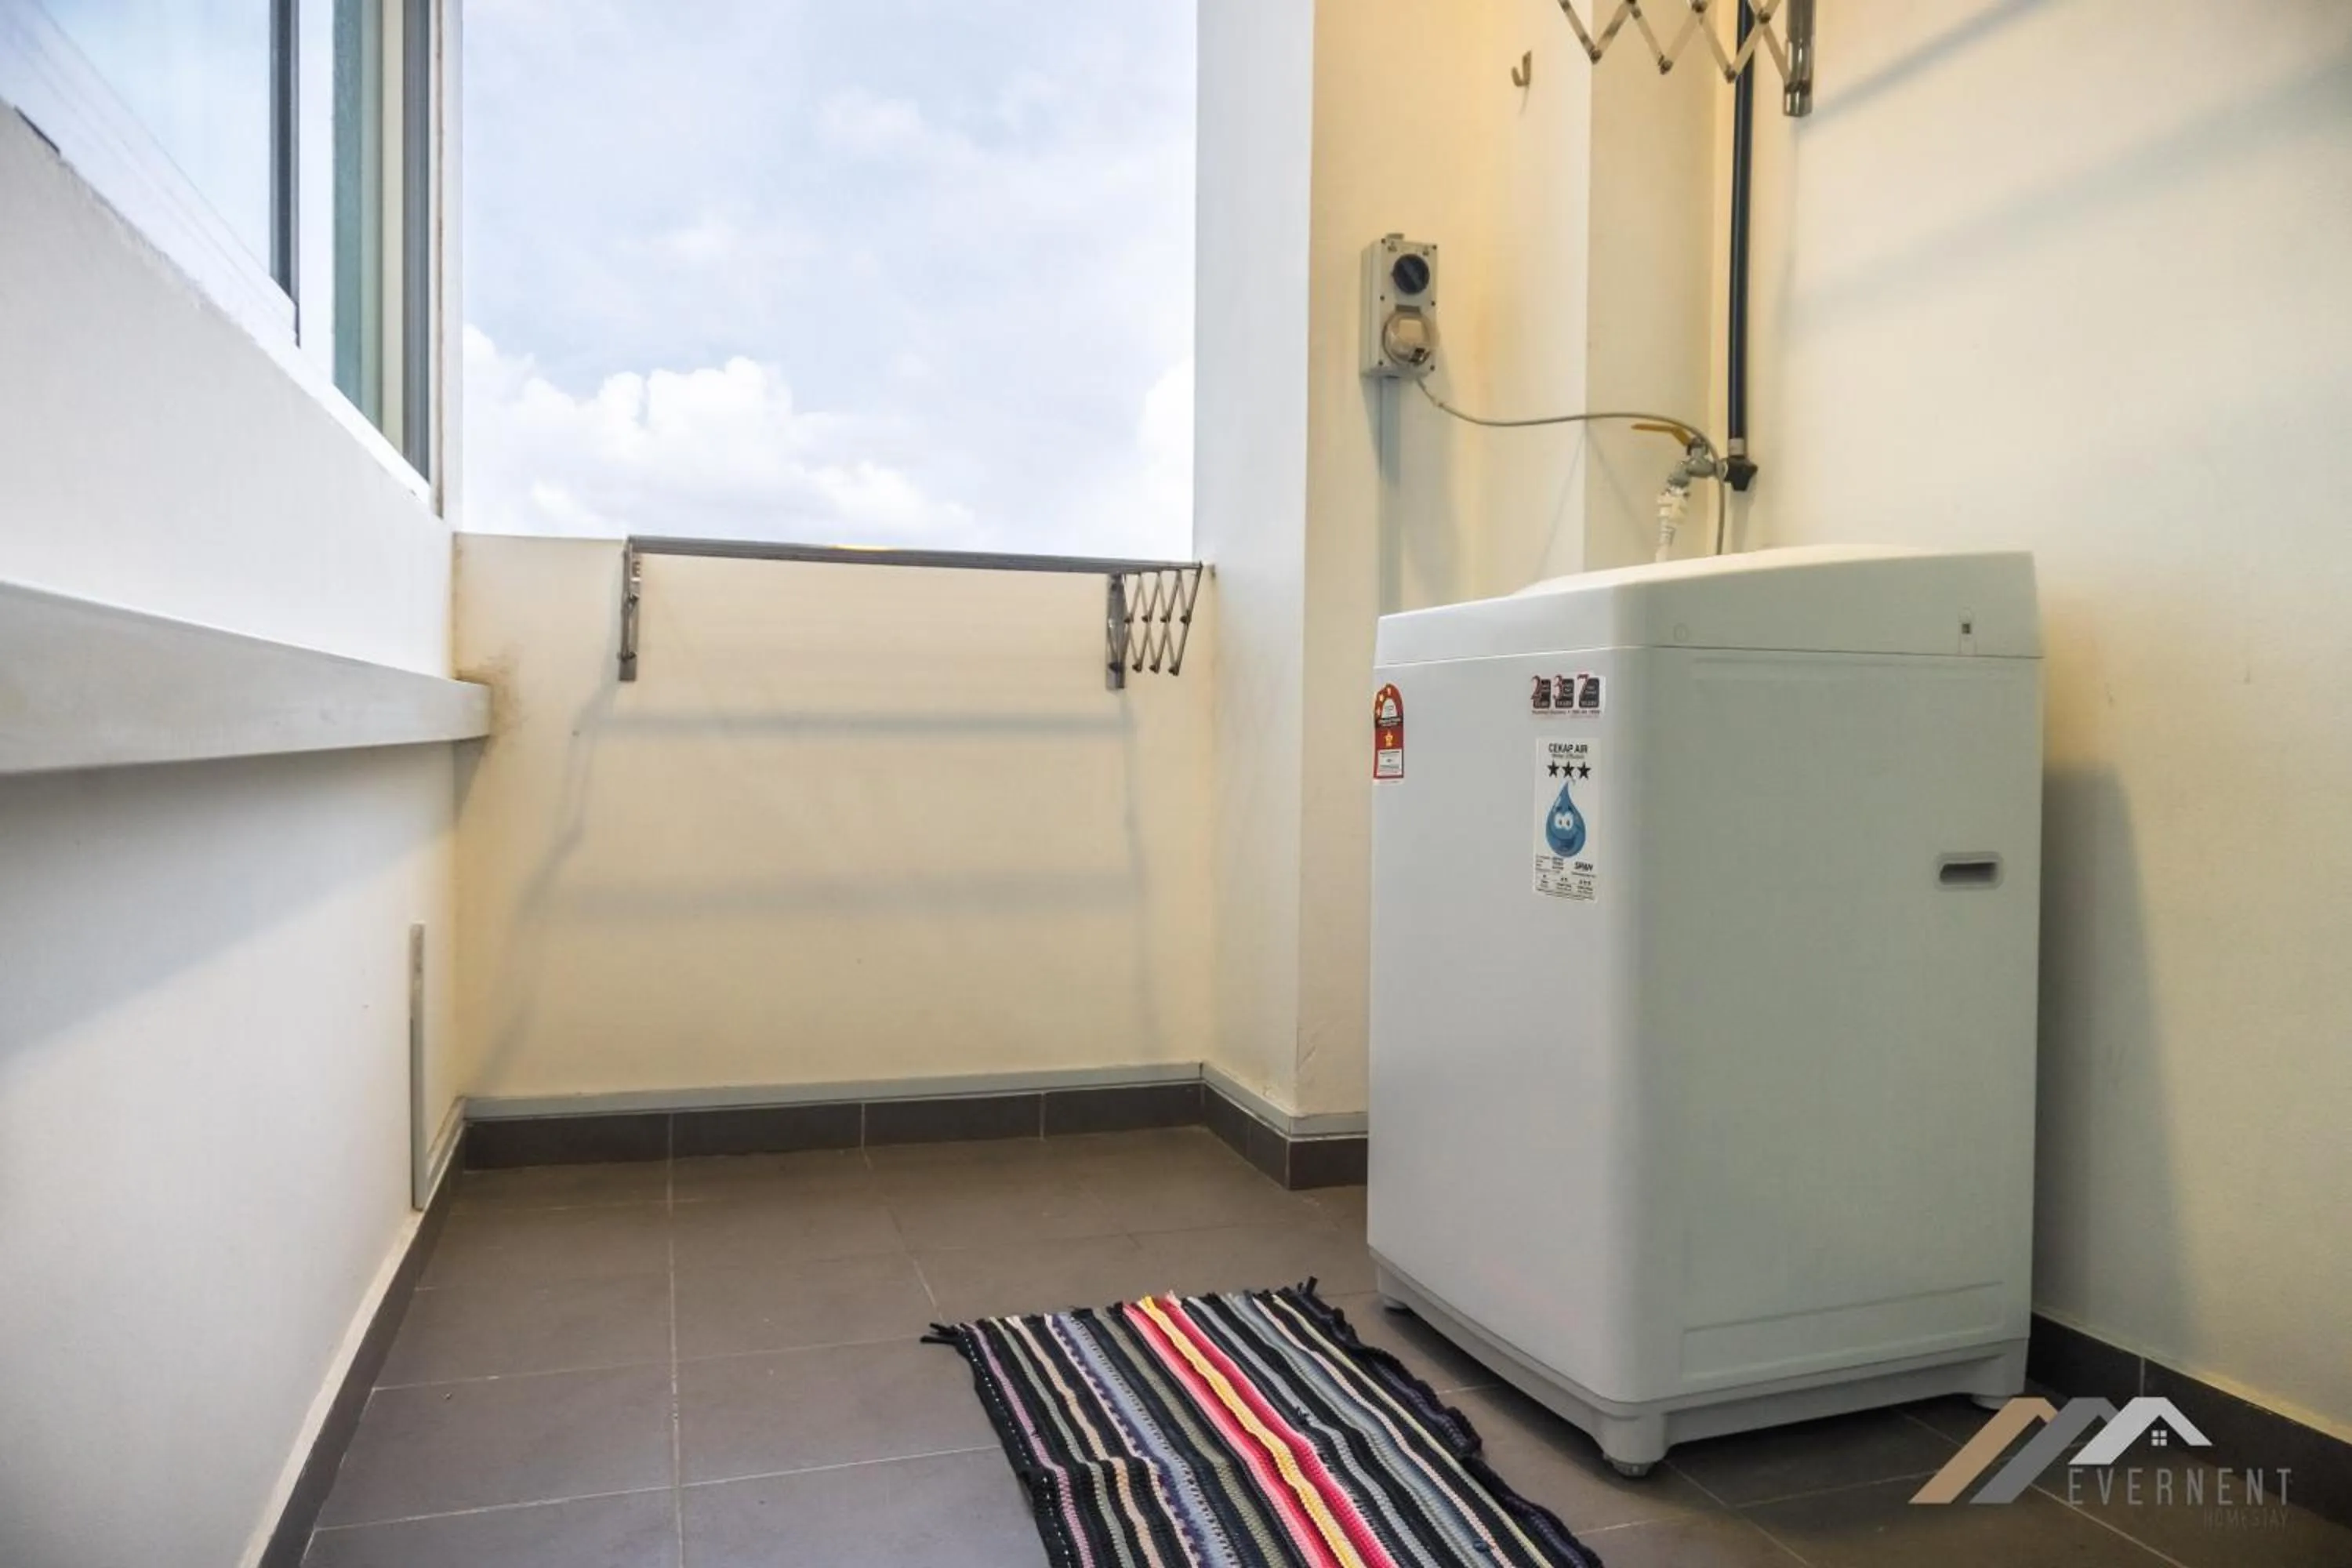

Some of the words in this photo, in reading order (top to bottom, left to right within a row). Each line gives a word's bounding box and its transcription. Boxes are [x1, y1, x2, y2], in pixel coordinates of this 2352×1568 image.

[1530, 674, 1541, 699] 2
[1552, 673, 1563, 699] 3
[1577, 673, 1589, 699] 7
[1548, 742, 1573, 753] CEKAP
[1574, 744, 1588, 753] AIR
